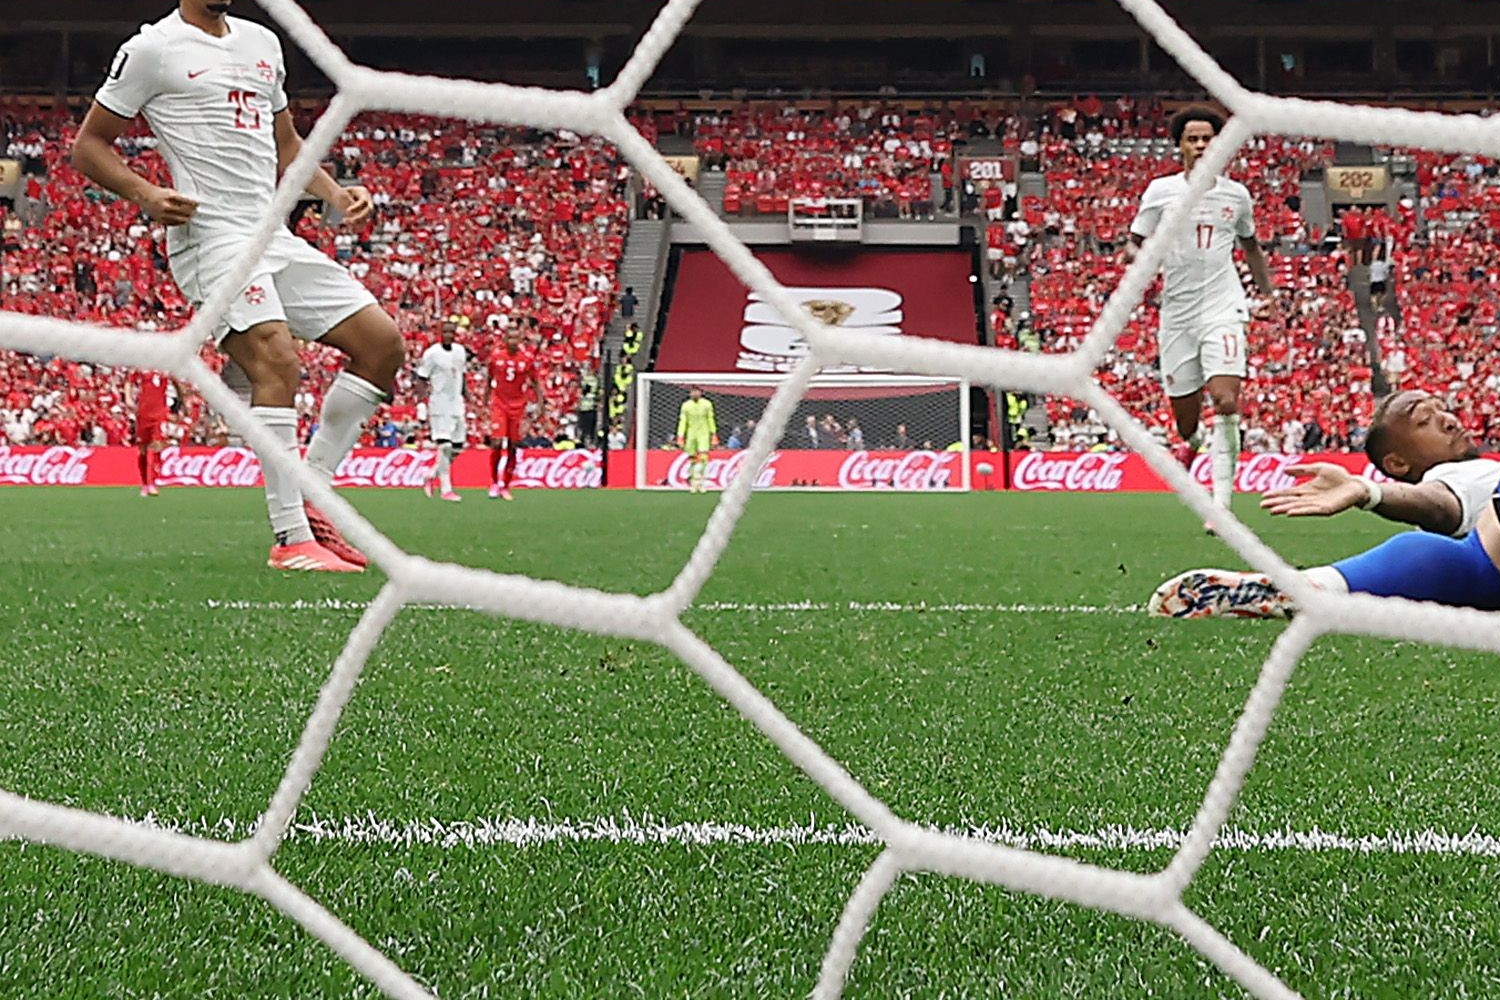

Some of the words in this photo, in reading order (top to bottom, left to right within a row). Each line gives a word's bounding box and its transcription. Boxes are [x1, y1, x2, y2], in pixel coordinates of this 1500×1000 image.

[969, 161, 1004, 180] 201
[1340, 171, 1374, 188] 202
[1196, 224, 1214, 249] 17
[1013, 452, 1128, 489] Coca-Cola
